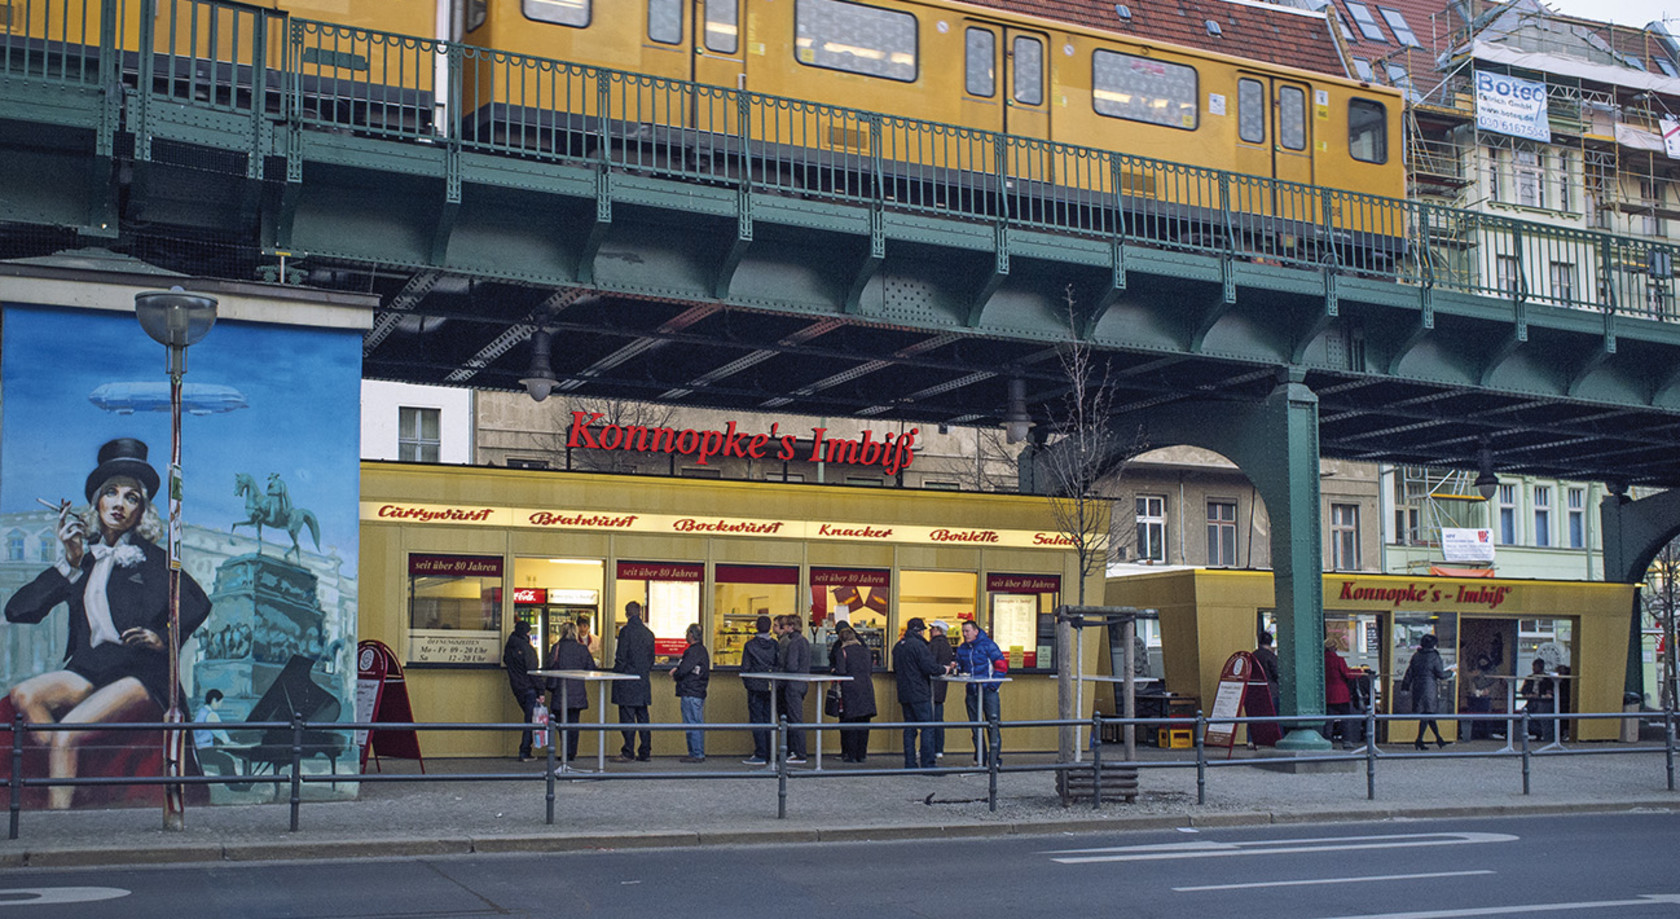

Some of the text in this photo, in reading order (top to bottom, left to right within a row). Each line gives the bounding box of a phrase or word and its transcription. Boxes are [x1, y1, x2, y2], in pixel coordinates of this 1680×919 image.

[1508, 99, 1533, 111] GmbH
[565, 411, 919, 476] Konnopke's Imbiß
[378, 505, 494, 521] Currywurst
[530, 512, 638, 528] Bratwurst
[673, 519, 783, 534] Bockwurst
[818, 524, 893, 538] Knacker
[930, 529, 999, 543] Boulette
[415, 560, 497, 572] seit über 80 Jahren
[623, 567, 699, 578] seit über 80 Jahren
[815, 573, 885, 584] seit über 80 Jahren
[420, 646, 432, 654] Mo
[438, 646, 448, 654] Fr
[474, 647, 488, 655] Uhr
